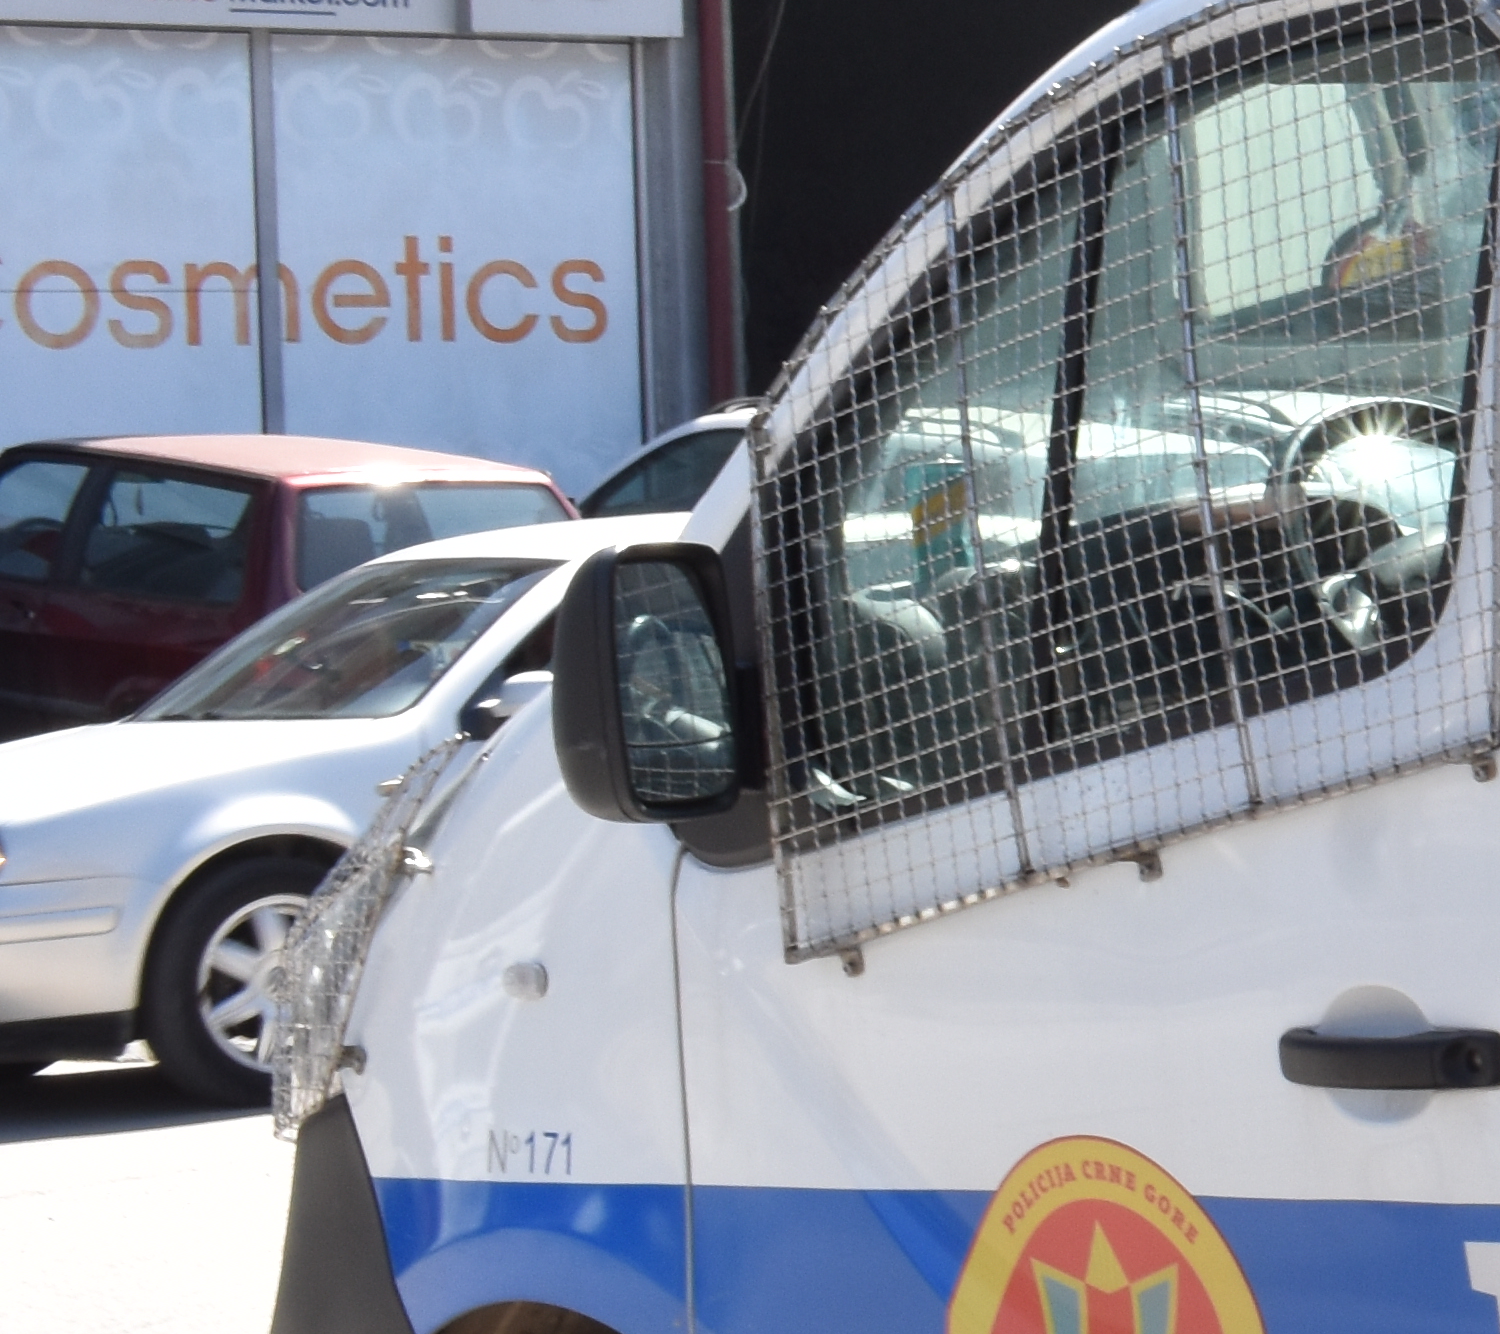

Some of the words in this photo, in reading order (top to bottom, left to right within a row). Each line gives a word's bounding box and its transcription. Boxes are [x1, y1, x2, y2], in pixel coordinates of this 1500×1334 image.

[0, 235, 608, 349] osmetics
[1081, 1159, 1136, 1192] CRNE
[1143, 1183, 1199, 1245] GORE
